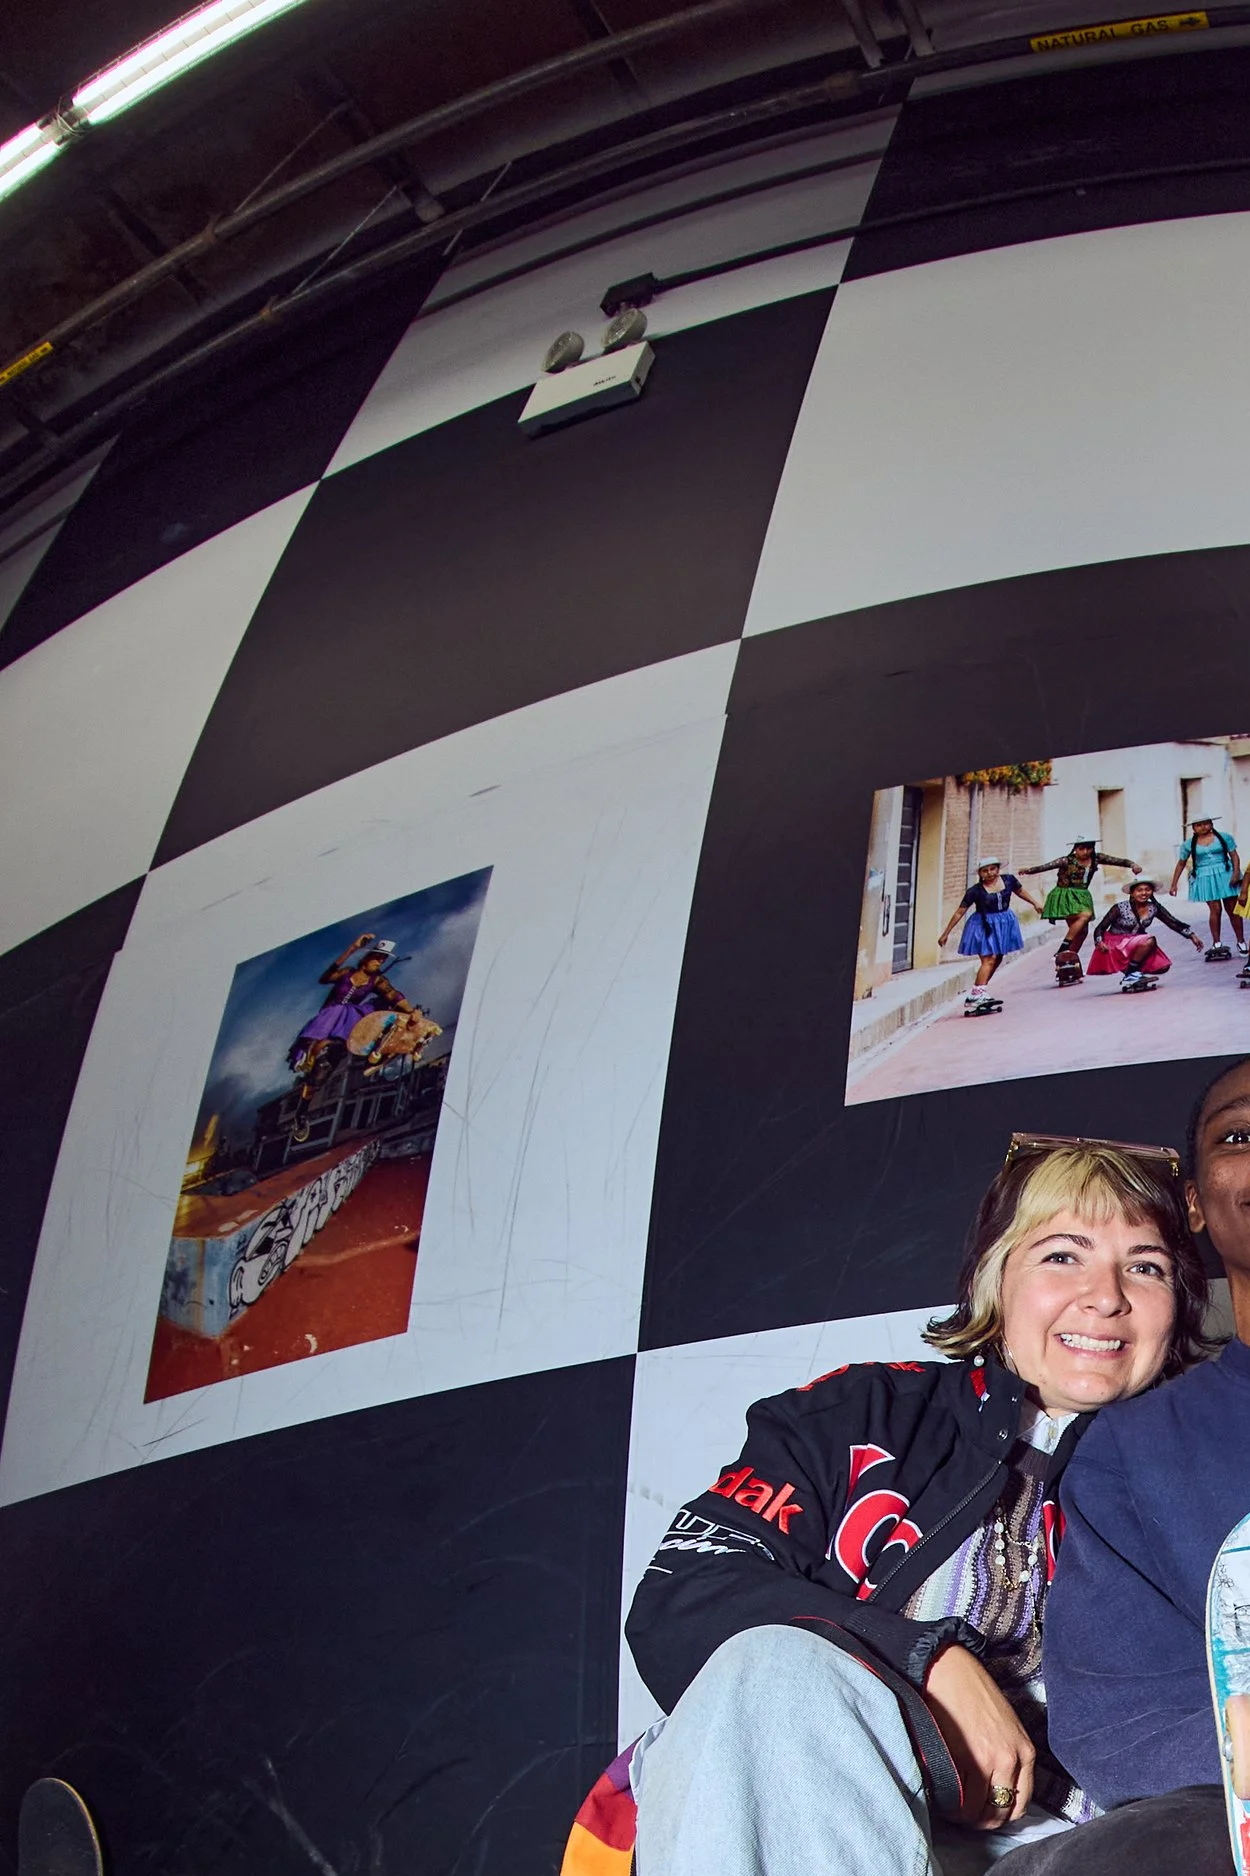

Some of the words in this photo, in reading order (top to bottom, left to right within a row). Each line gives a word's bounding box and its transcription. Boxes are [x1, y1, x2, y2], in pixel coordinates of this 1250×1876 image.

[1036, 28, 1116, 51] NATURAL
[1130, 20, 1169, 36] GAS
[709, 1466, 803, 1535] dak
